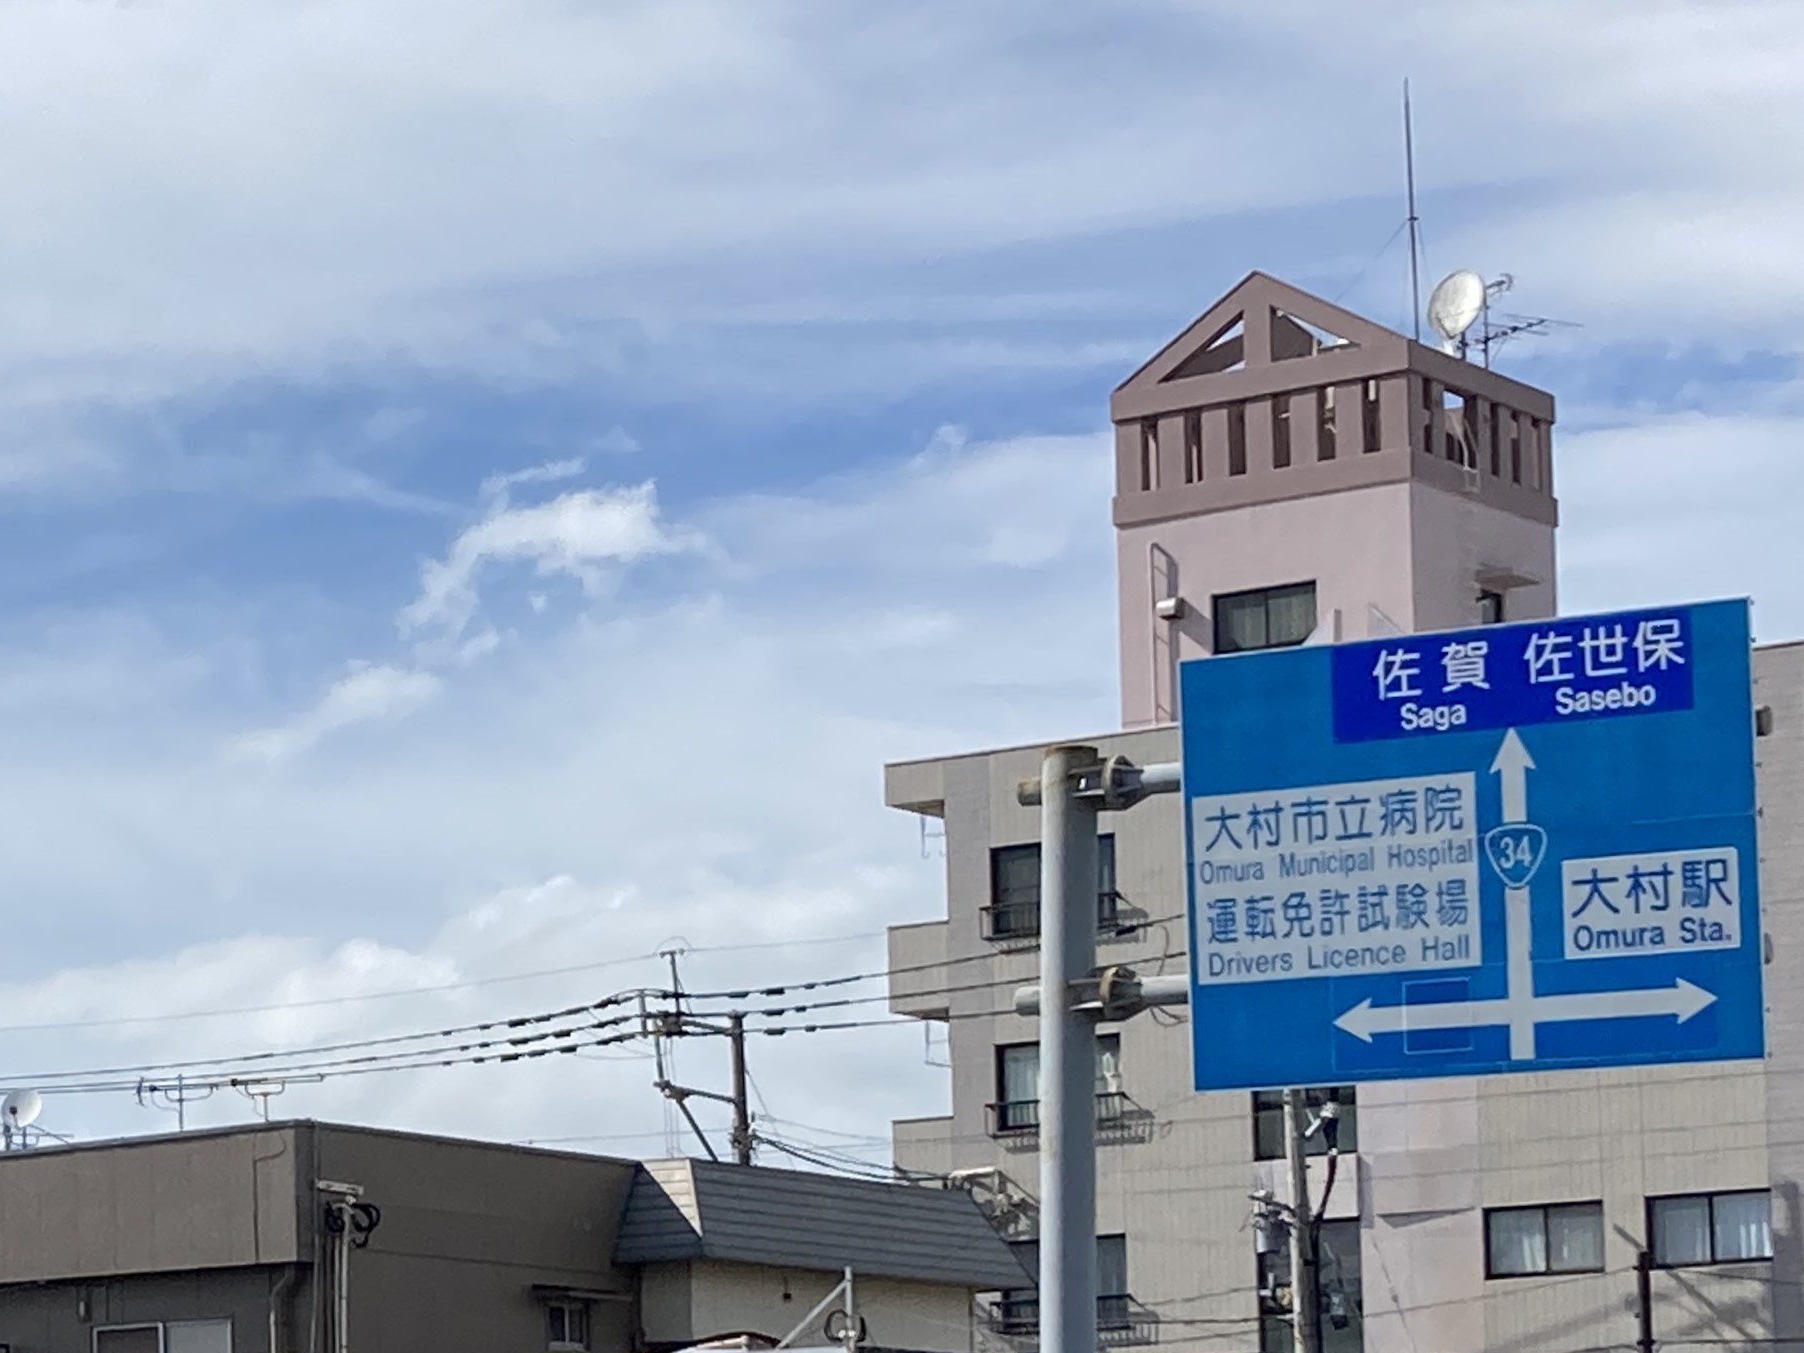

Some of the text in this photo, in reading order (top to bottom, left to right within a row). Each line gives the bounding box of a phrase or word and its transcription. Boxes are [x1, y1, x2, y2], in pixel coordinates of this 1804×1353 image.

[1372, 641, 1491, 700] 佐賀
[1523, 618, 1685, 684] 佐世保
[1400, 703, 1467, 730] Saga
[1555, 682, 1657, 714] Sasebo
[1205, 785, 1464, 852] 大村市立病院
[1200, 837, 1474, 884] Omura Municipal Hospital
[1499, 835, 1532, 869] 34
[1207, 878, 1469, 944] 運転免許試験場
[1571, 858, 1733, 918] 大村駅
[1208, 934, 1471, 977] Drivers Licence Hall
[1573, 917, 1733, 951] Omura Sta.
